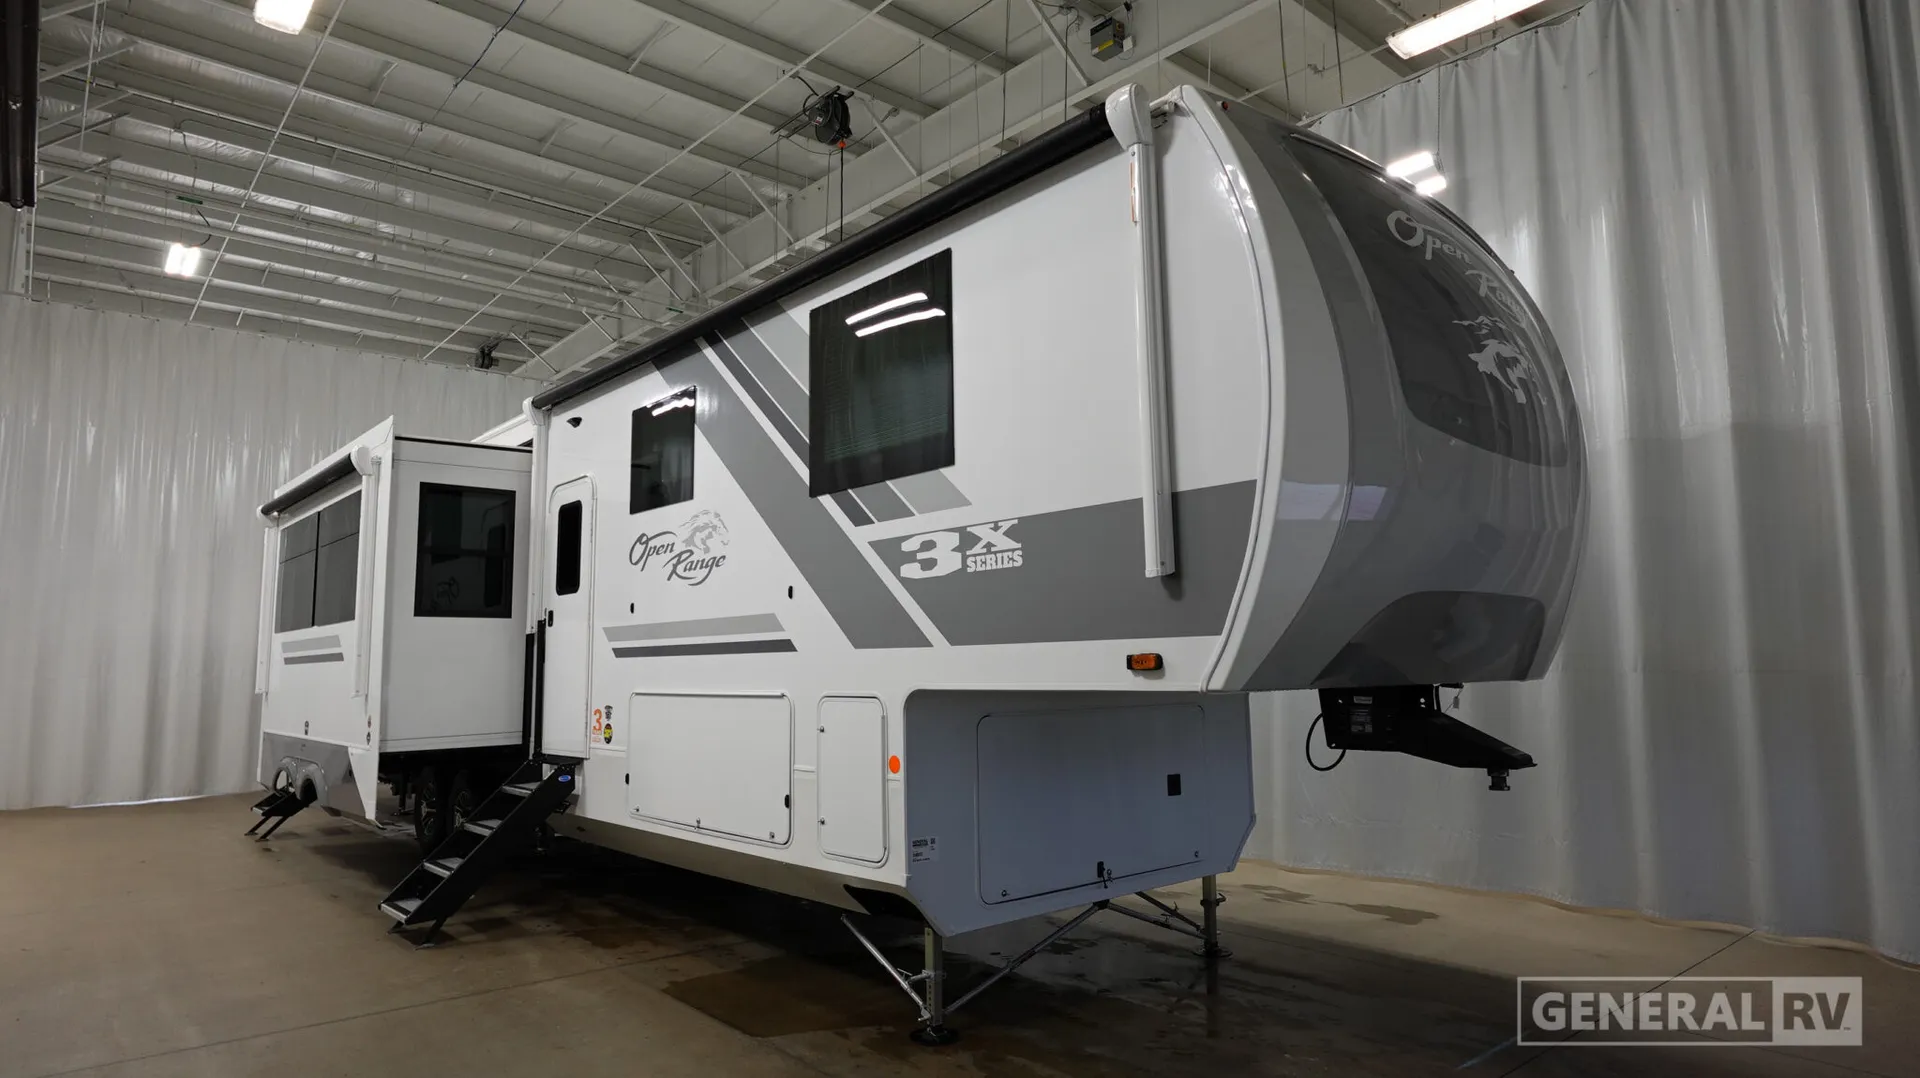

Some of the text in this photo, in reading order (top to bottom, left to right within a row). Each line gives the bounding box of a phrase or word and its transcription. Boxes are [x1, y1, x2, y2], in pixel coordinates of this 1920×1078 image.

[1386, 210, 1472, 264] Open
[629, 530, 677, 572] Open
[662, 549, 727, 587] Range
[966, 550, 1023, 573] SERIES
